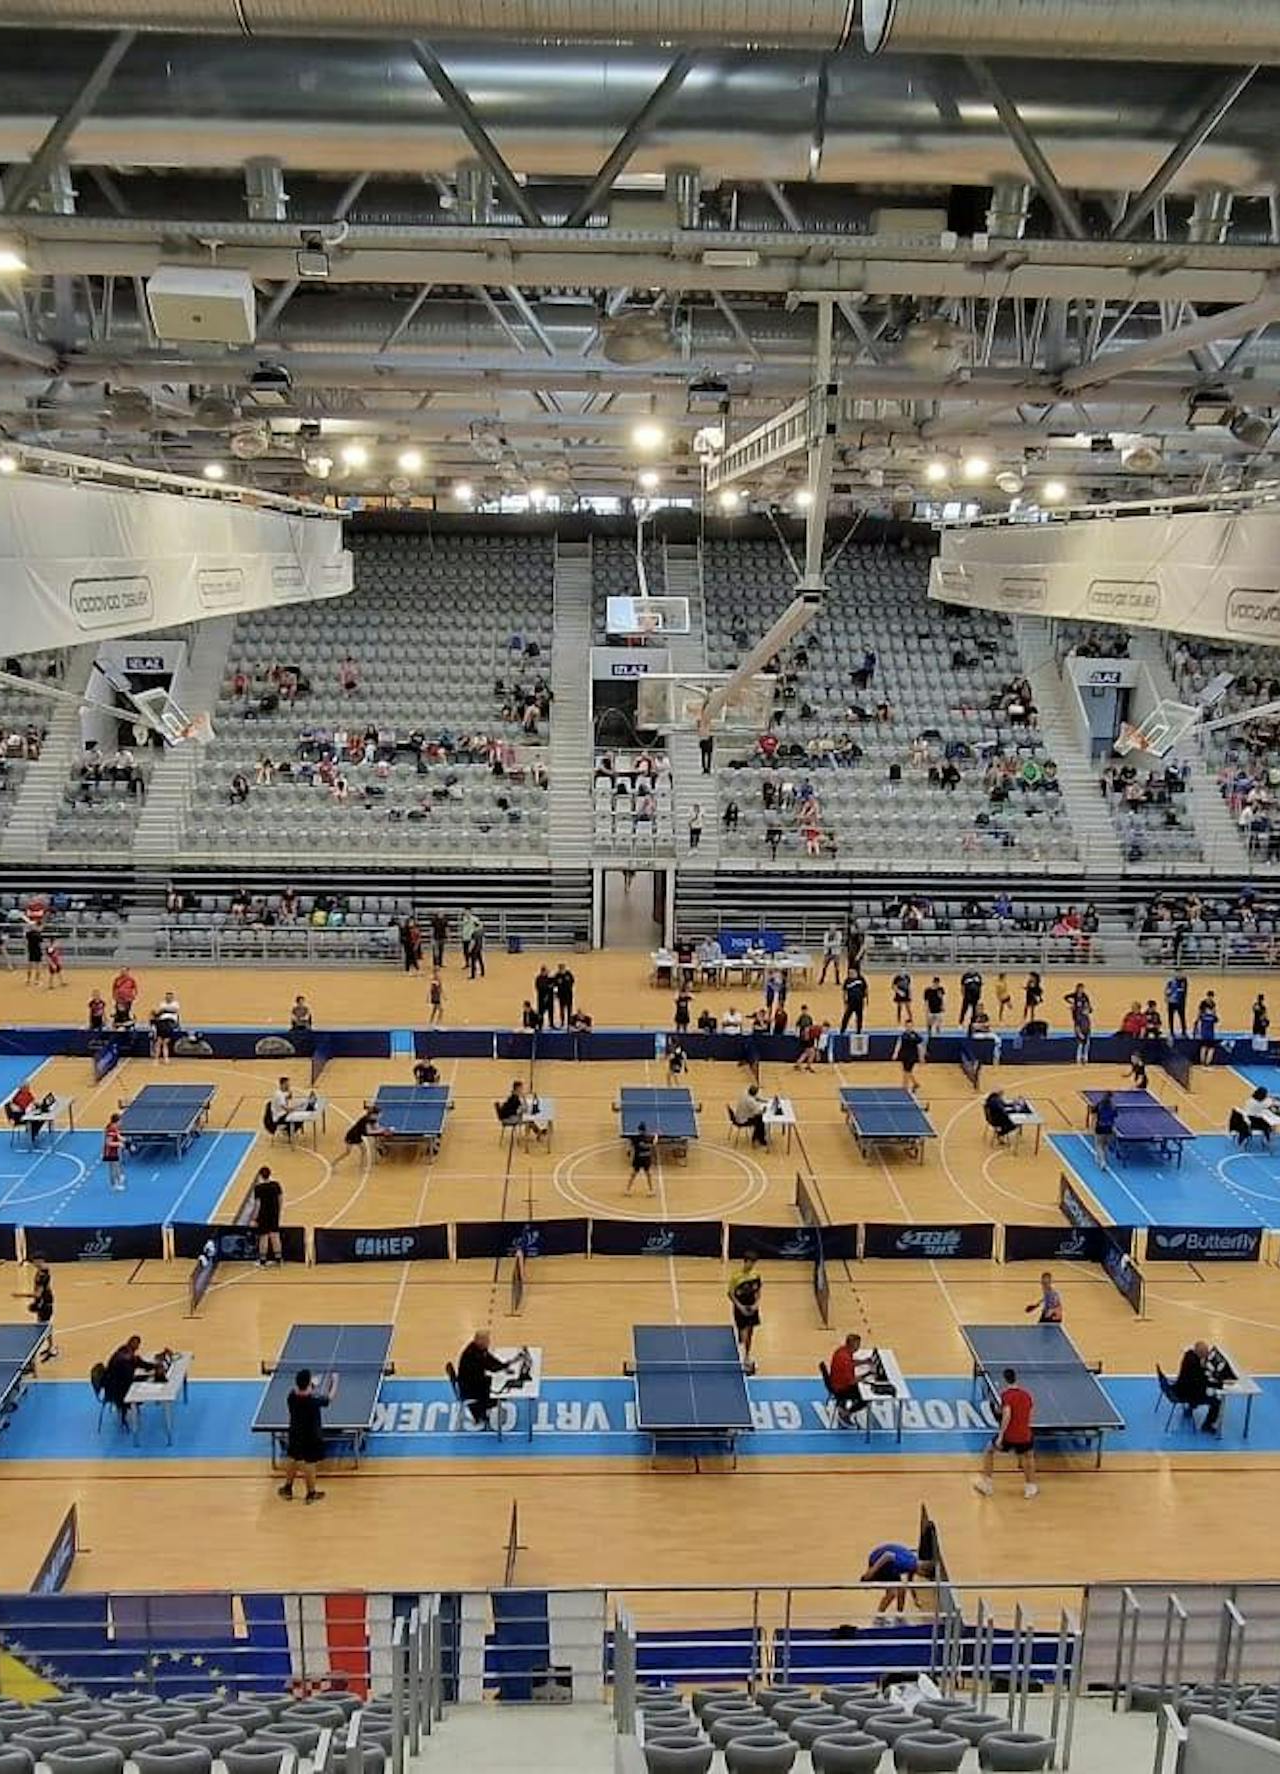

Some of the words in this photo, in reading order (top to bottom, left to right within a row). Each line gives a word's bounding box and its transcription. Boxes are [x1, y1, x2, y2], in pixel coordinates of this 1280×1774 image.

[374, 1236, 415, 1255] HEP
[1186, 1233, 1257, 1251] Butterfly
[532, 1401, 610, 1431] VRT
